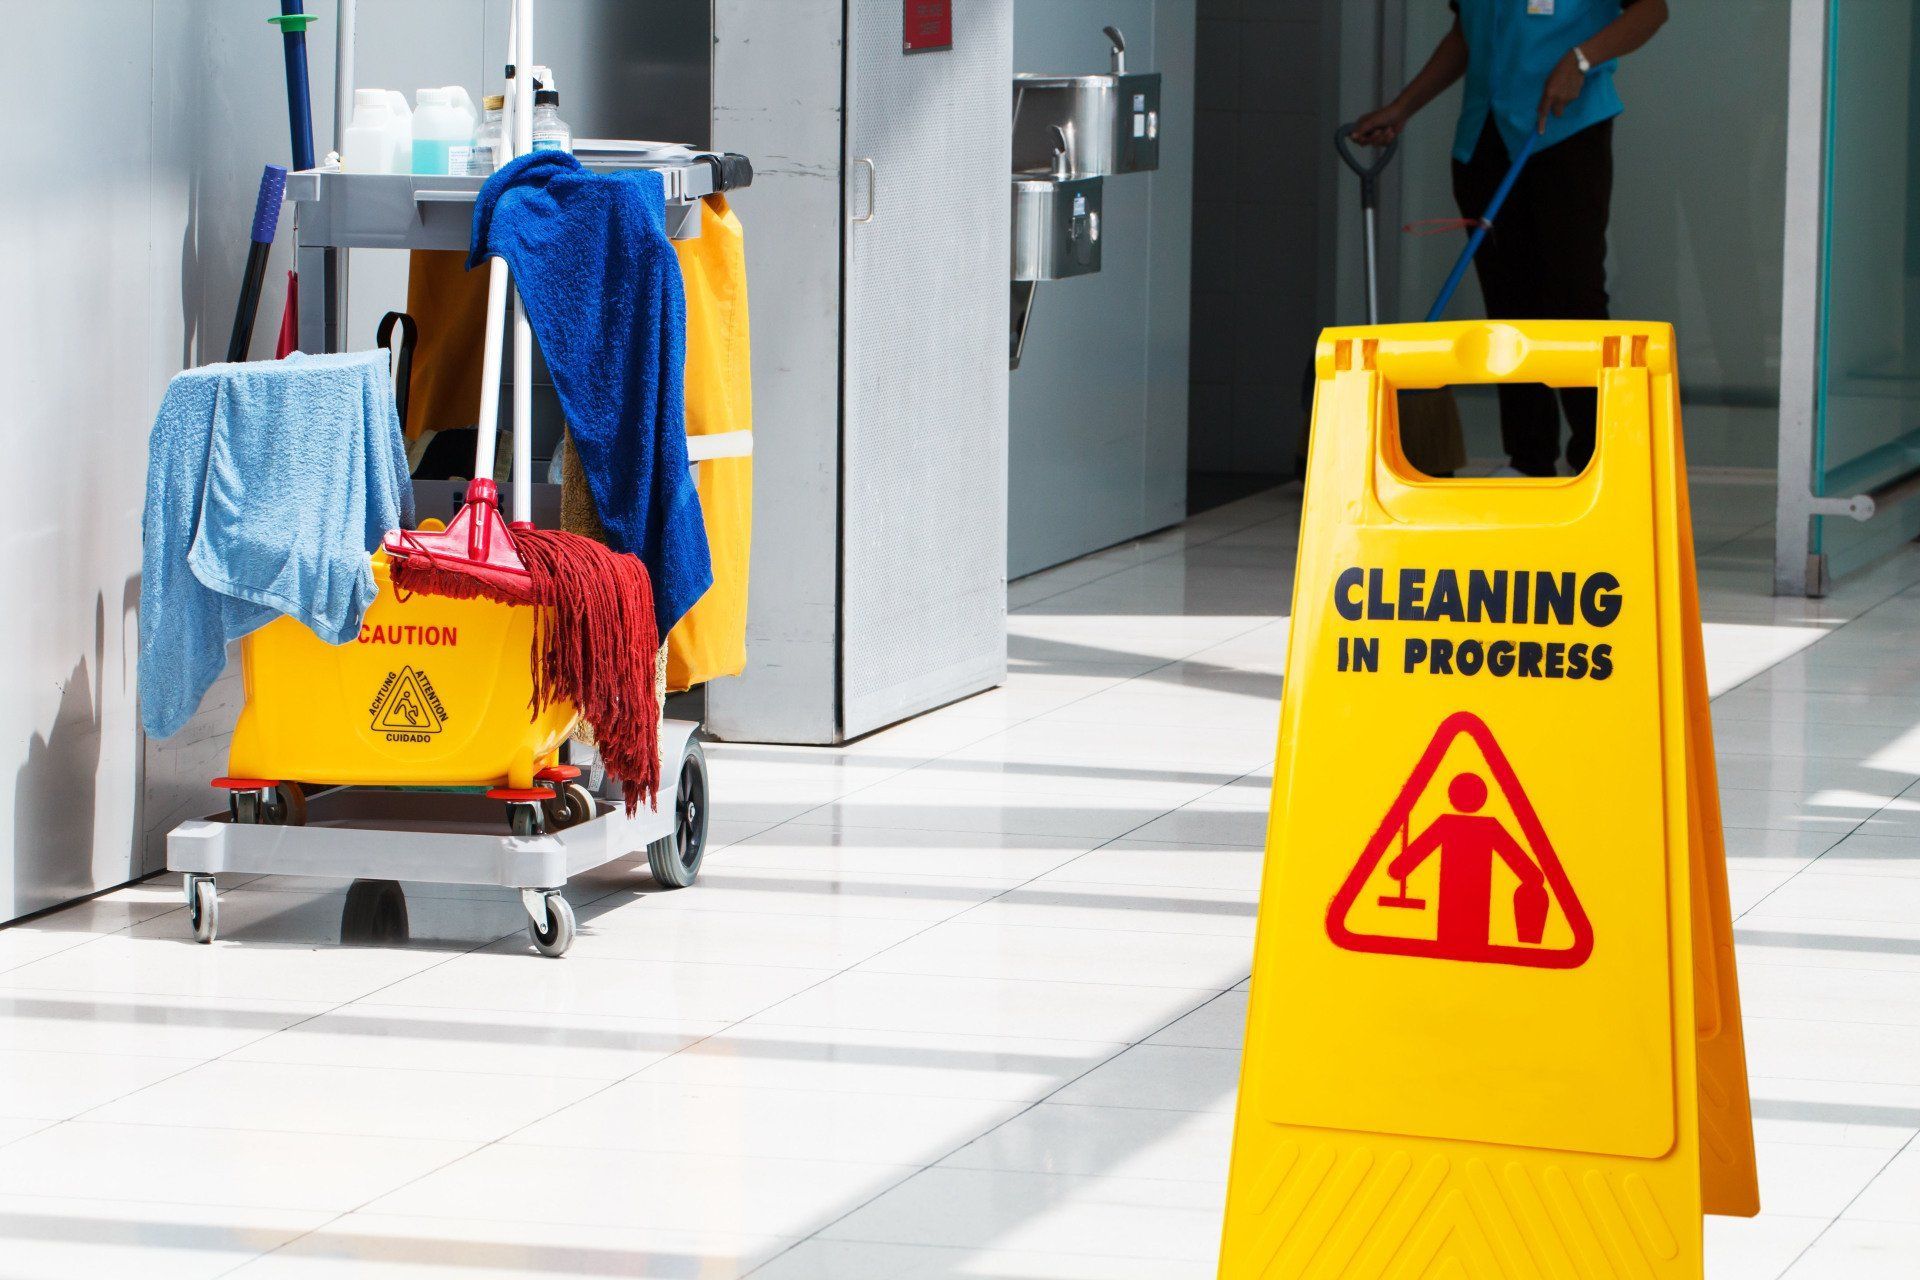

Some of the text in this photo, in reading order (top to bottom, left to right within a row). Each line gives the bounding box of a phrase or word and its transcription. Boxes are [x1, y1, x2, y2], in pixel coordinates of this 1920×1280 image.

[1334, 567, 1623, 628] CLEANING
[357, 624, 457, 647] CAUTION
[1337, 637, 1614, 681] IN PROGRESS
[368, 671, 397, 716] ACHTUNG
[415, 670, 449, 722] ATTENTION
[386, 733, 431, 743] CUIDADO
